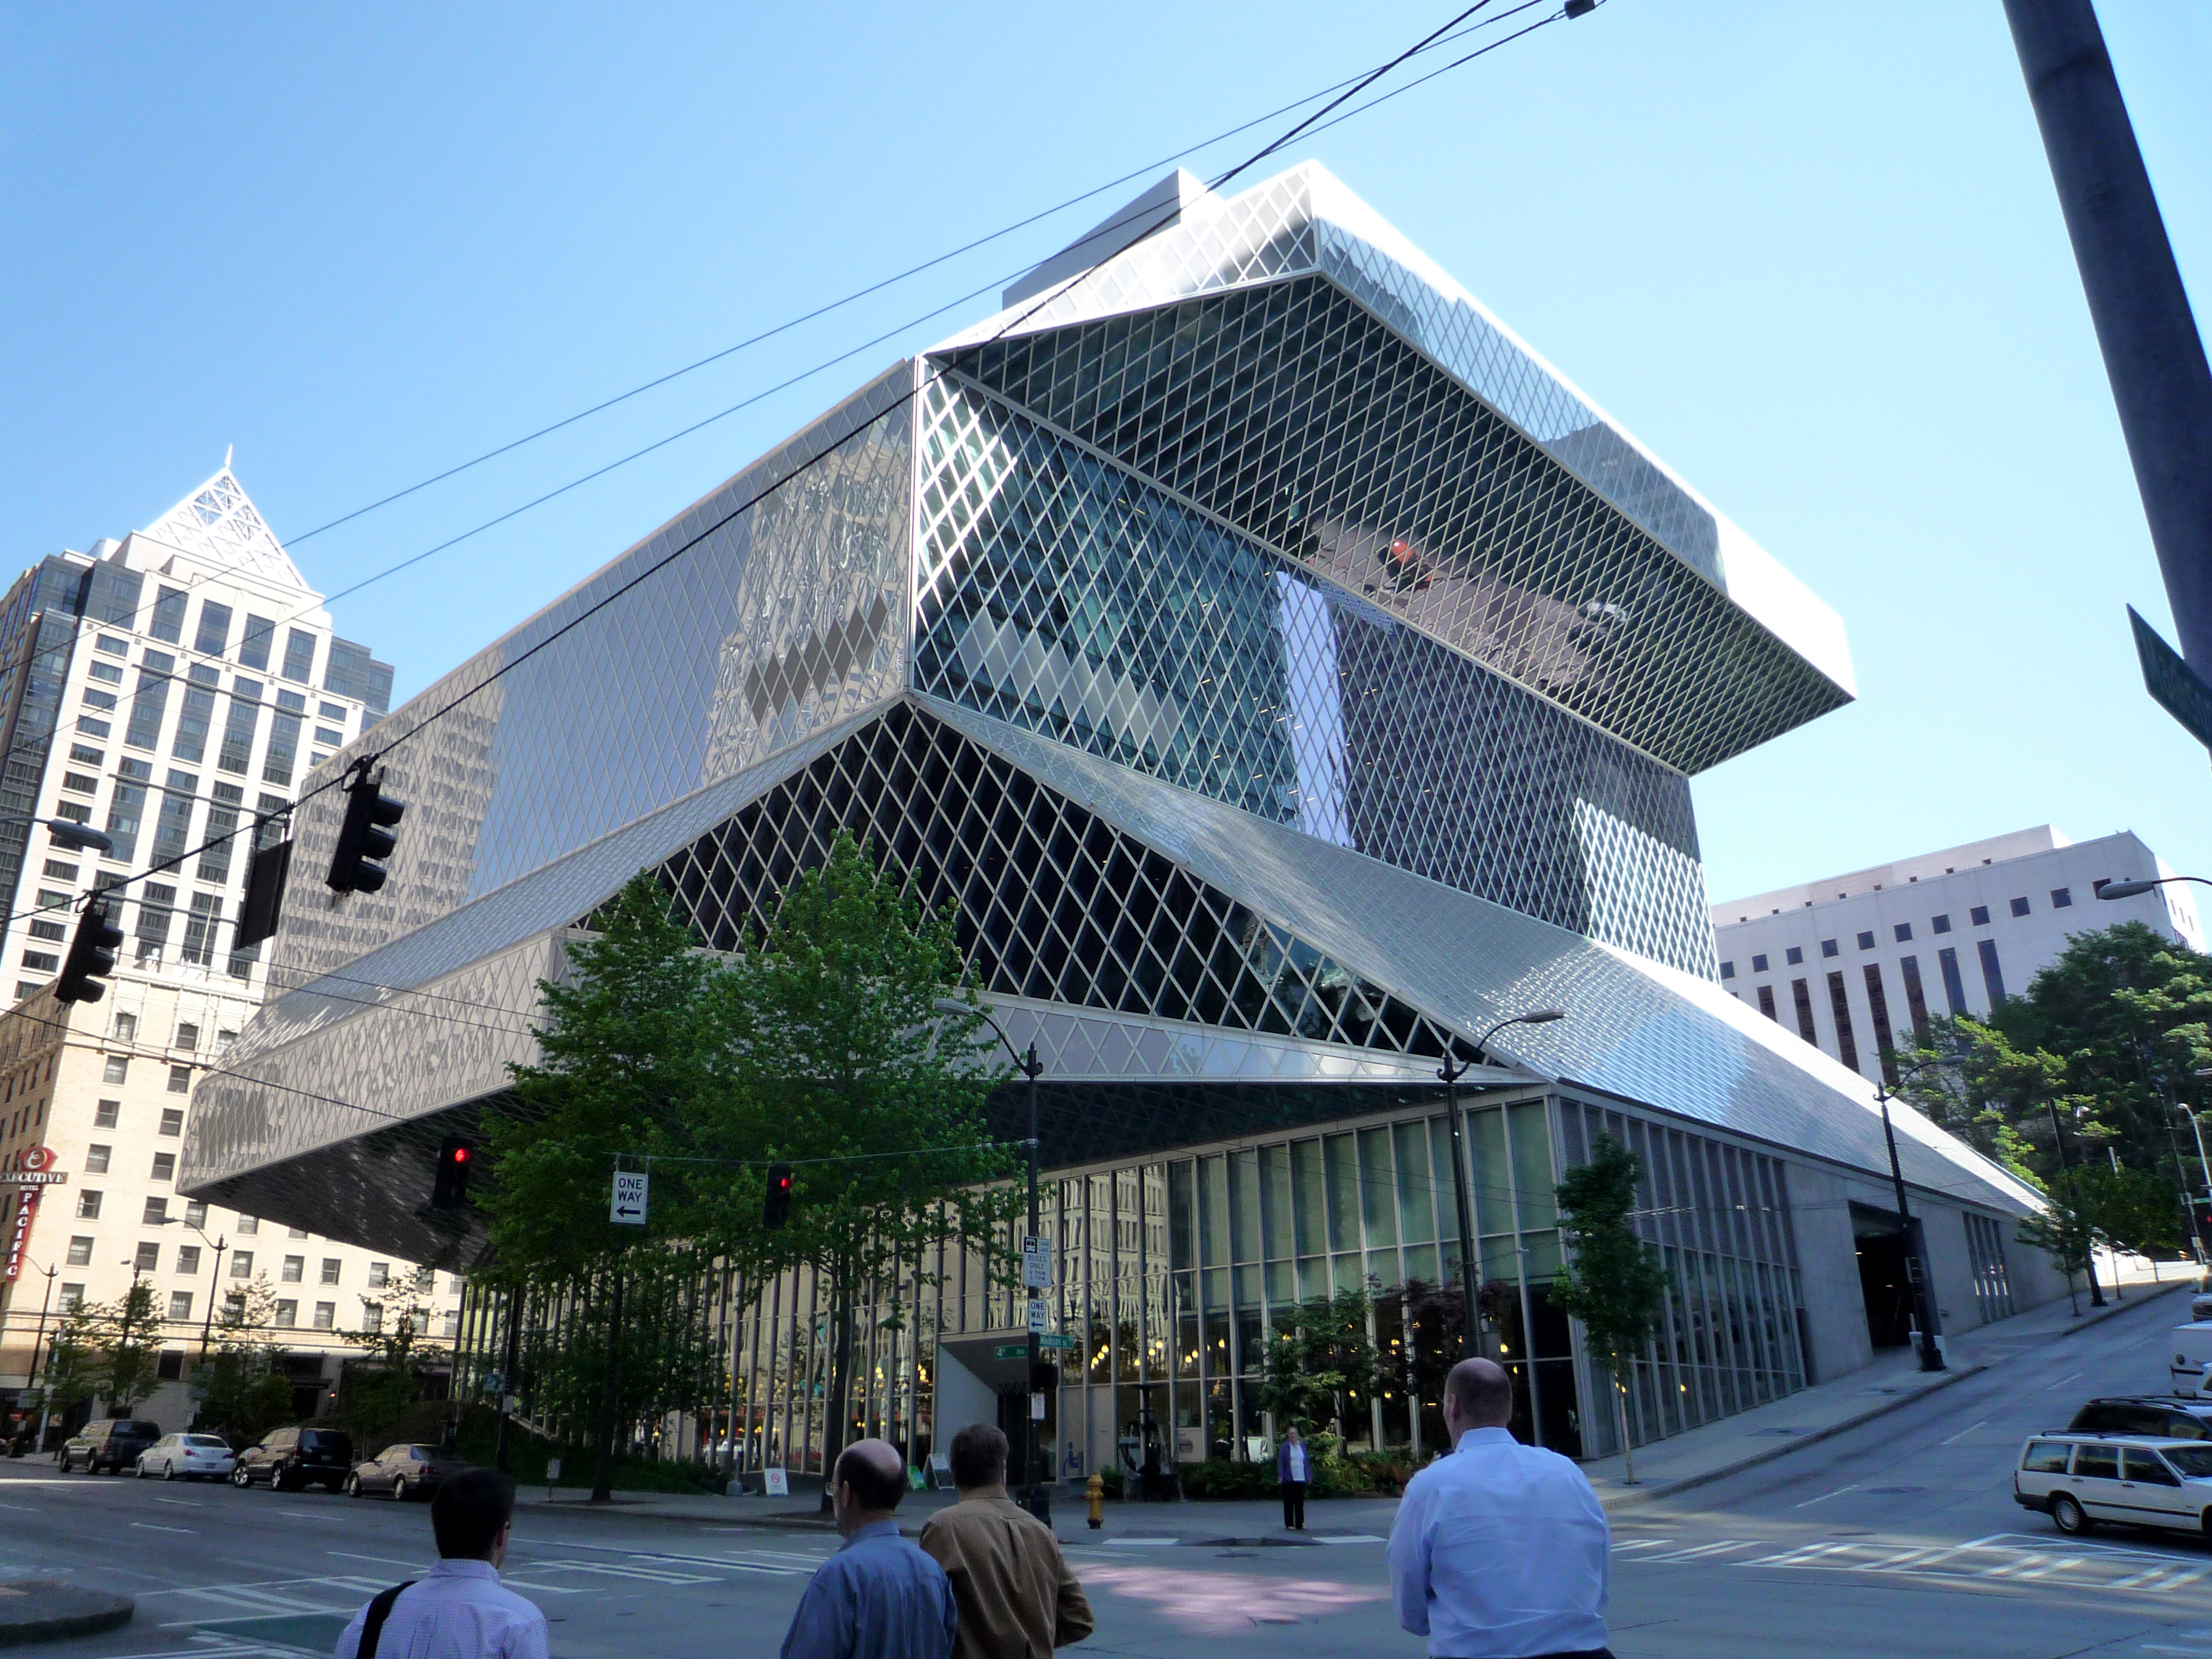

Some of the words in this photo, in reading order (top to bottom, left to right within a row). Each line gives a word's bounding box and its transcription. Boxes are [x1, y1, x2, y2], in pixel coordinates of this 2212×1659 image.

[618, 1178, 643, 1190] ONE
[618, 1190, 642, 1202] WAY
[7, 1192, 33, 1276] PACIFIC
[1031, 1301, 1044, 1310] ONE
[1031, 1310, 1045, 1319] WAY
[1040, 1335, 1061, 1346] Madison
